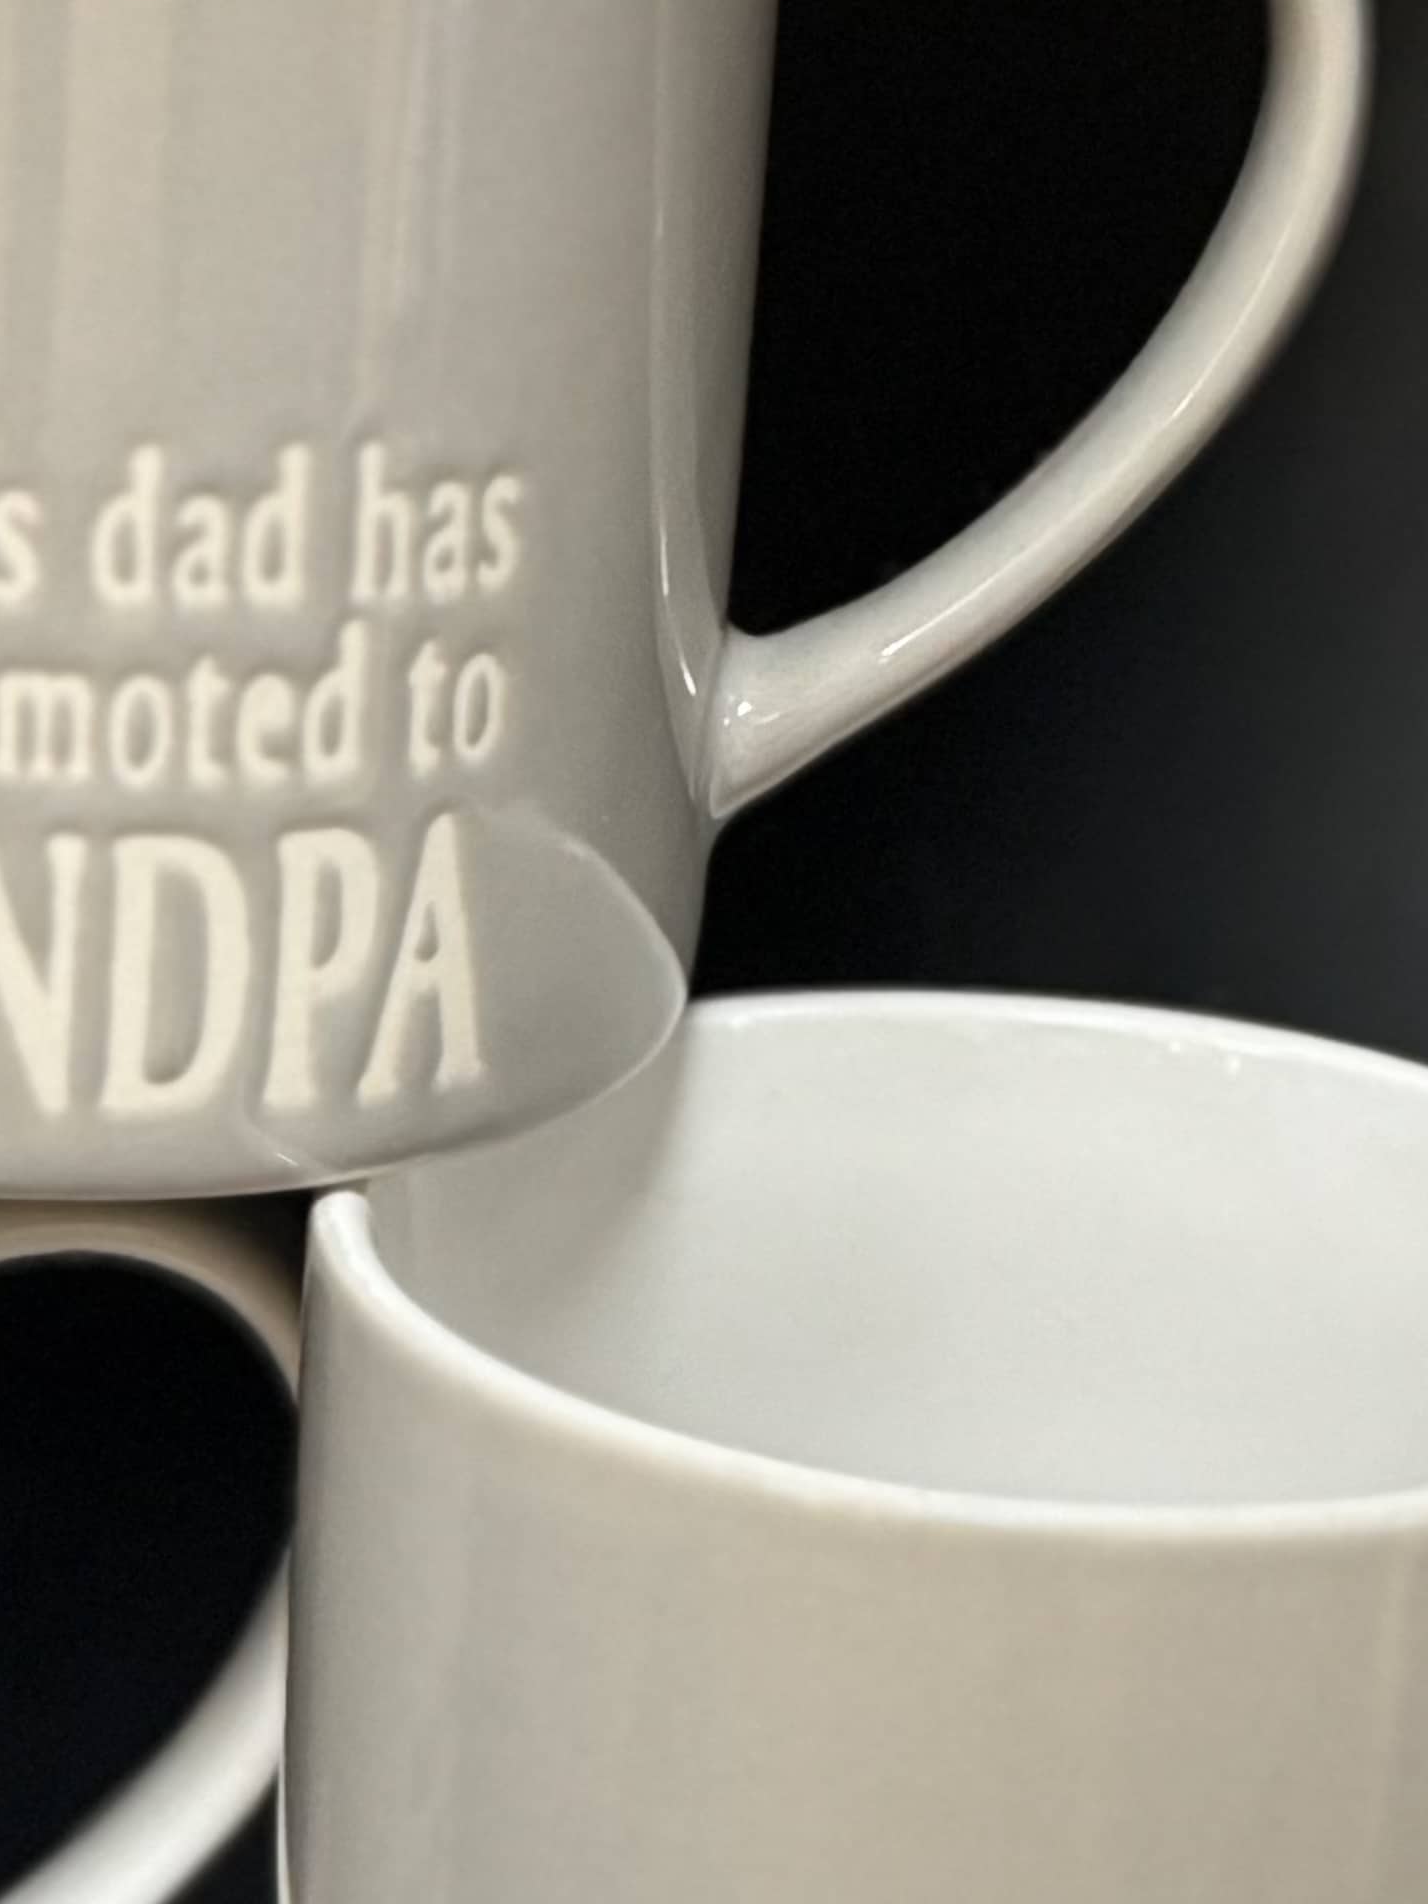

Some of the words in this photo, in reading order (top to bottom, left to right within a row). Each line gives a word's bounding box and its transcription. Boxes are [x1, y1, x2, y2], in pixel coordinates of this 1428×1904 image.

[92, 442, 308, 605] dad
[350, 440, 521, 602] has
[407, 639, 505, 775] to
